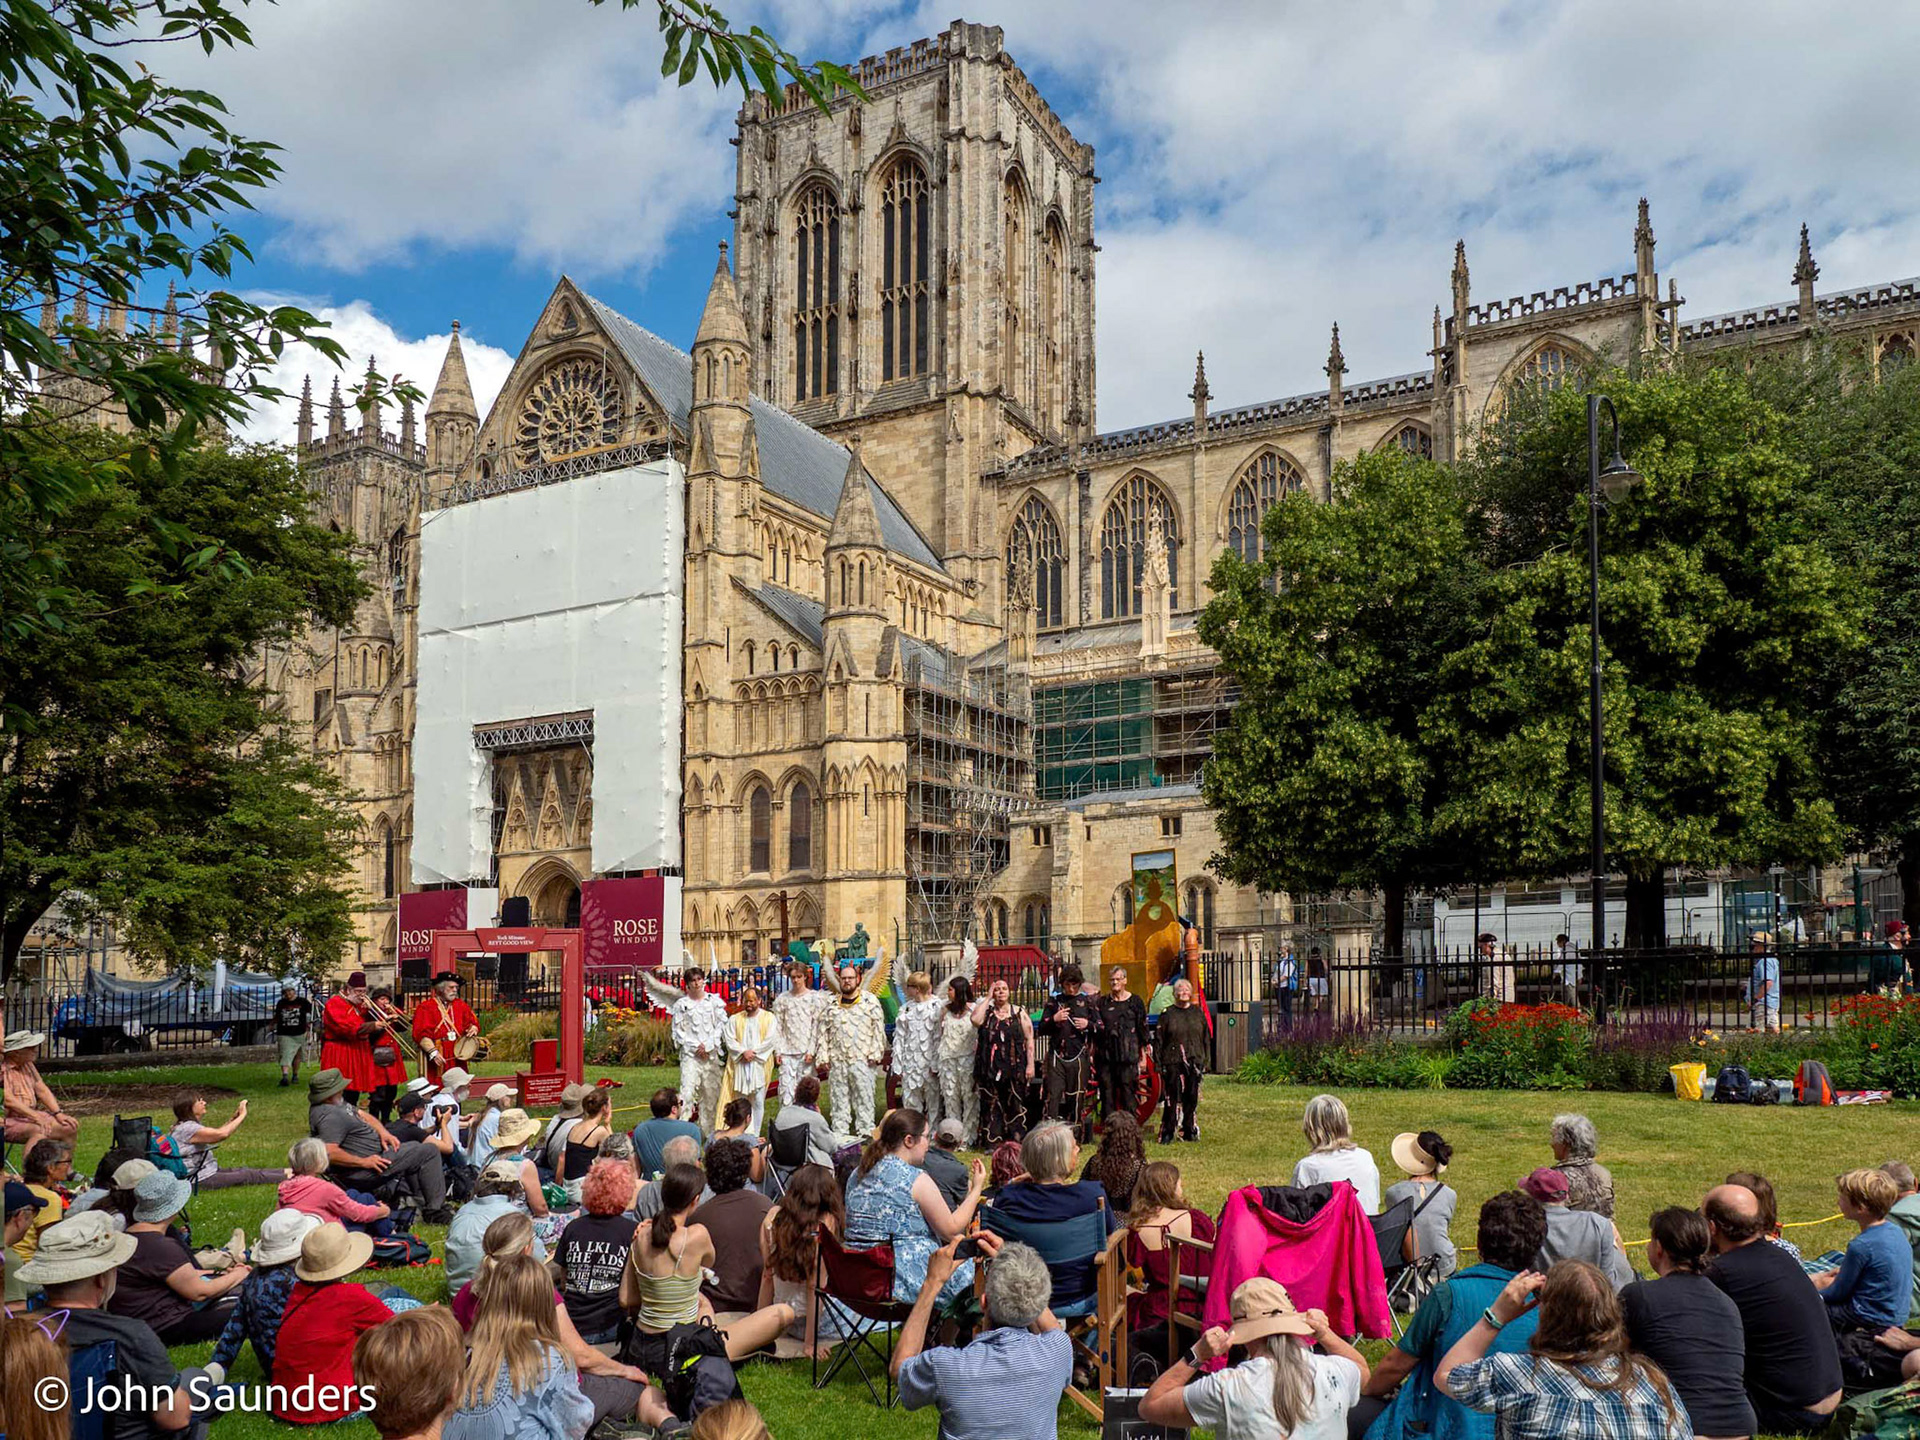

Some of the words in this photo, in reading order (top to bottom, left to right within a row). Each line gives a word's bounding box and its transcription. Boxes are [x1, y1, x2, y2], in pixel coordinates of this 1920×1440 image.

[613, 918, 658, 936] ROSE
[613, 936, 657, 944] WINDOW
[401, 945, 431, 953] WINDO
